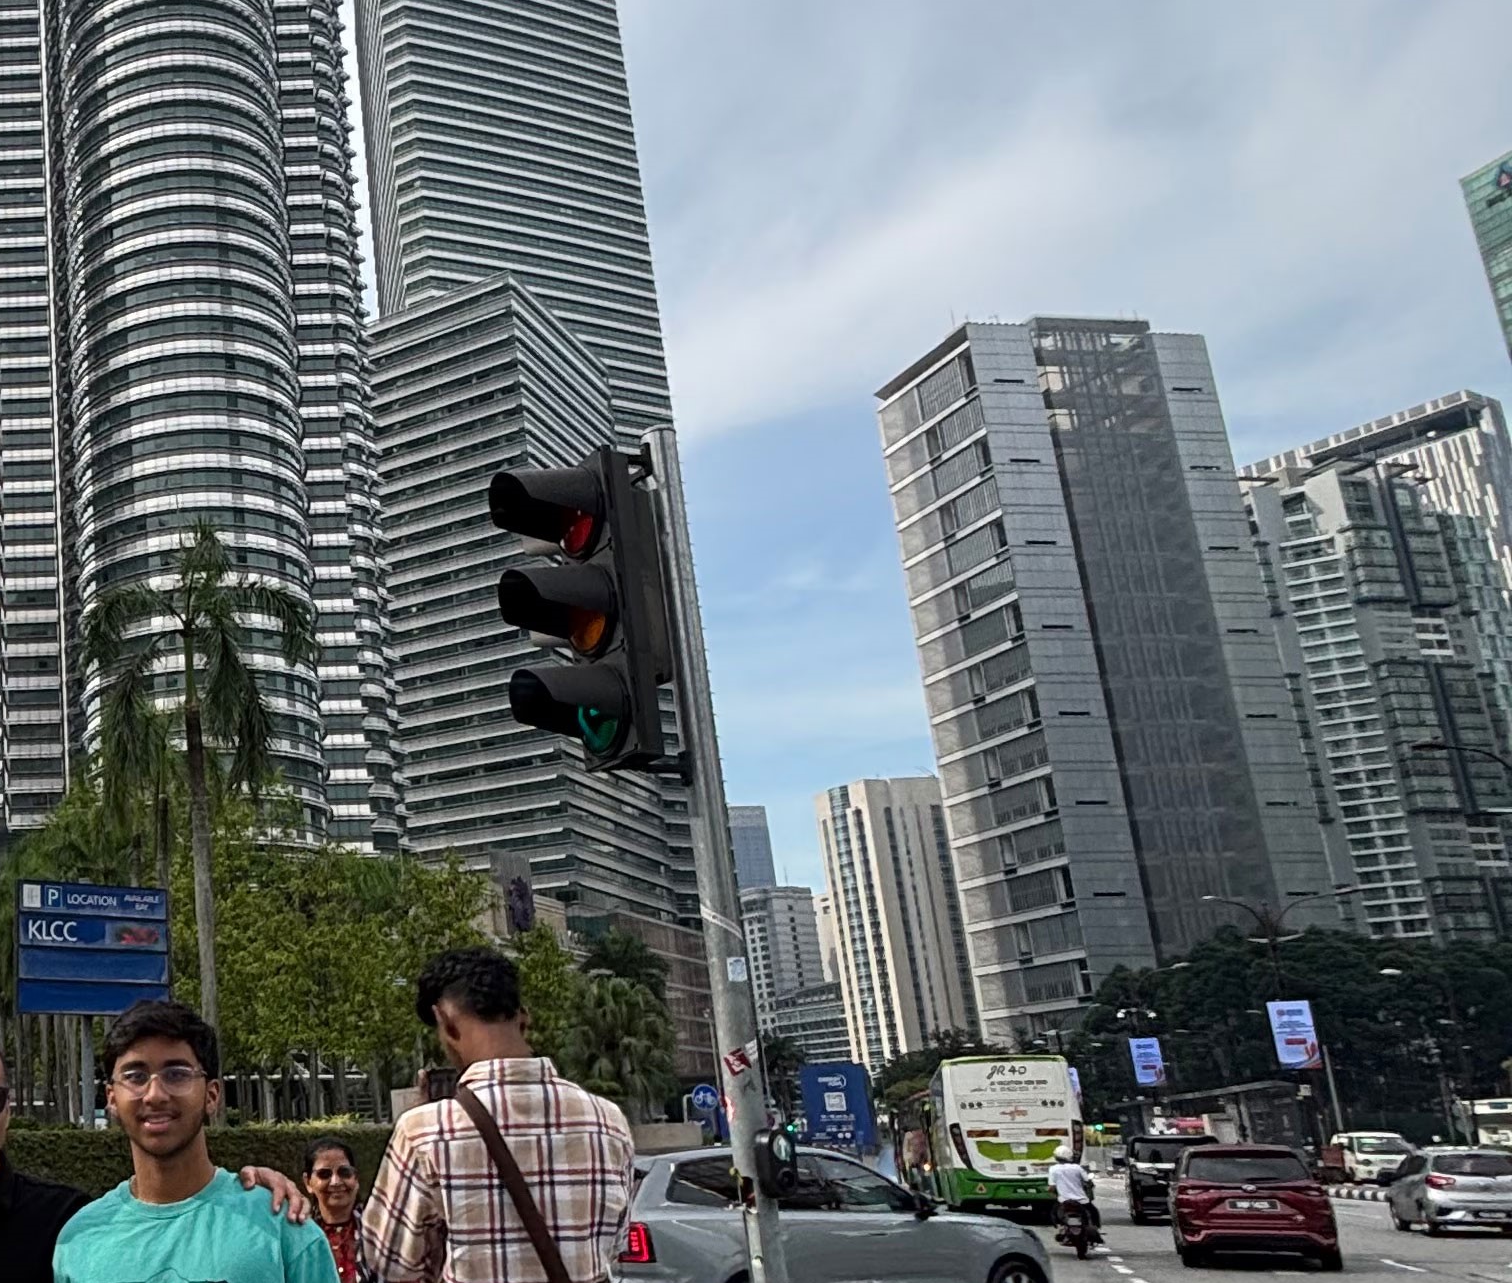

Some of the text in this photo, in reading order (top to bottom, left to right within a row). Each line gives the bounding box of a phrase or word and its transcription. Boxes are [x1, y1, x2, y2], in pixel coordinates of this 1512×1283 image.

[48, 888, 117, 907] P LOCATION
[28, 919, 78, 942] KLCC
[1008, 1065, 1027, 1075] 40
